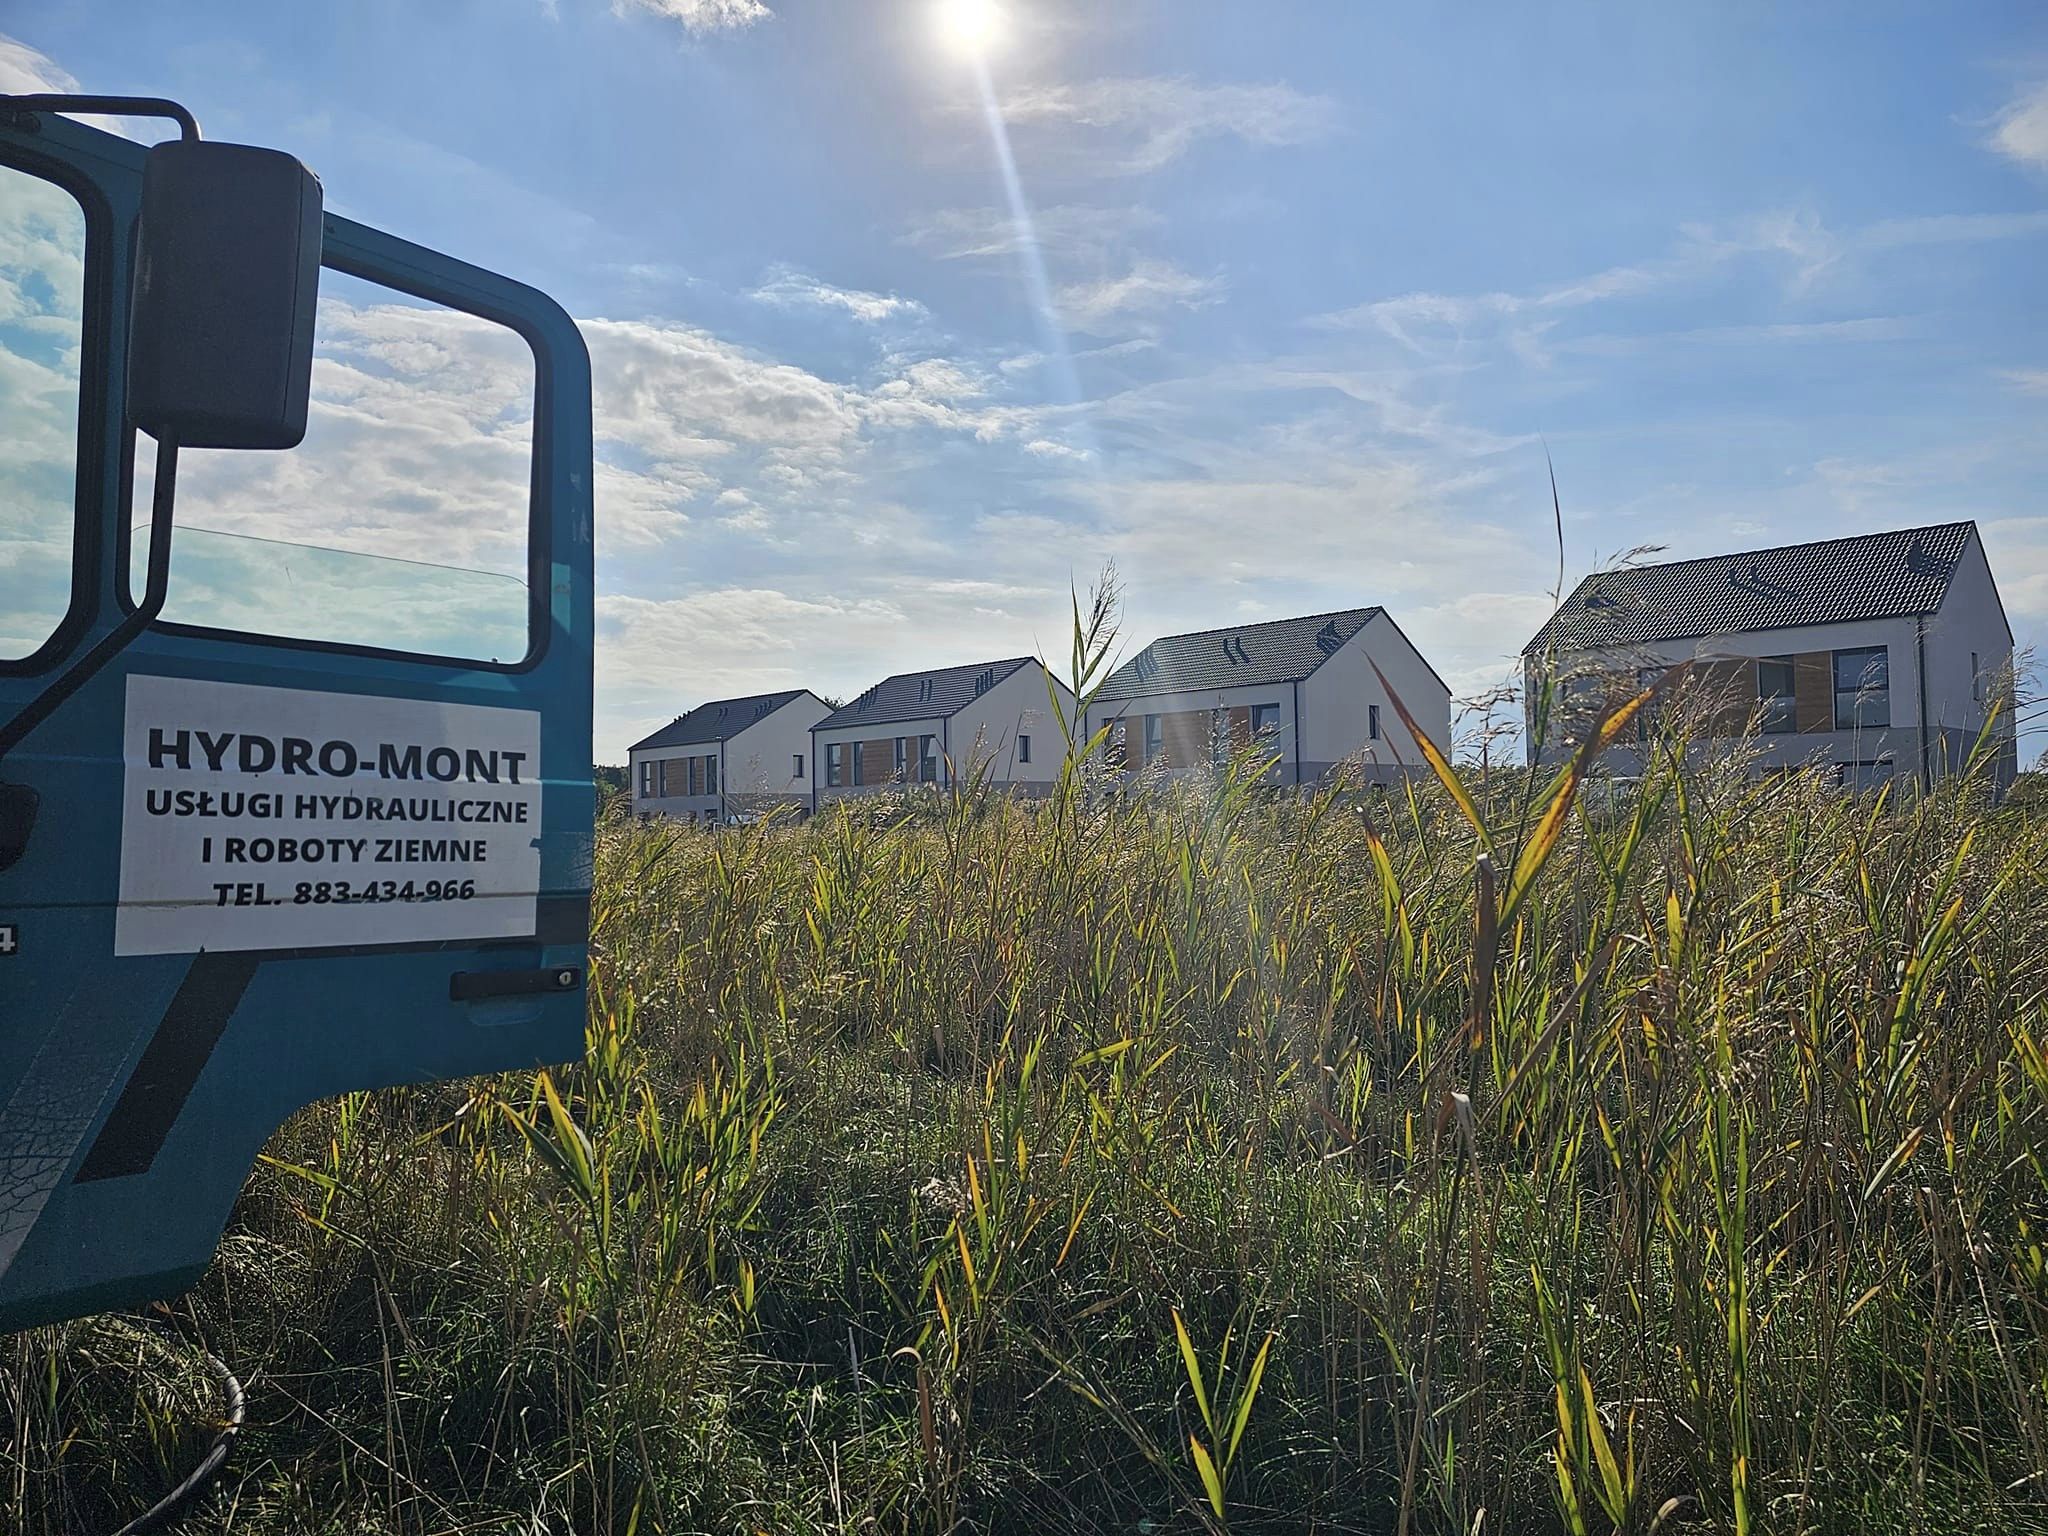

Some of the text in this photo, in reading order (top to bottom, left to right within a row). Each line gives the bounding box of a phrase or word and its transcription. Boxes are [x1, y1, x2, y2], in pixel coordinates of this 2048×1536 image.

[147, 727, 527, 785] HYDRO-MONT
[146, 789, 529, 823] USŁUGI HYDRAULICZNE
[202, 837, 487, 863] I ROBOTY ZIEMNE
[213, 879, 476, 907] TEL. 883-434-966
